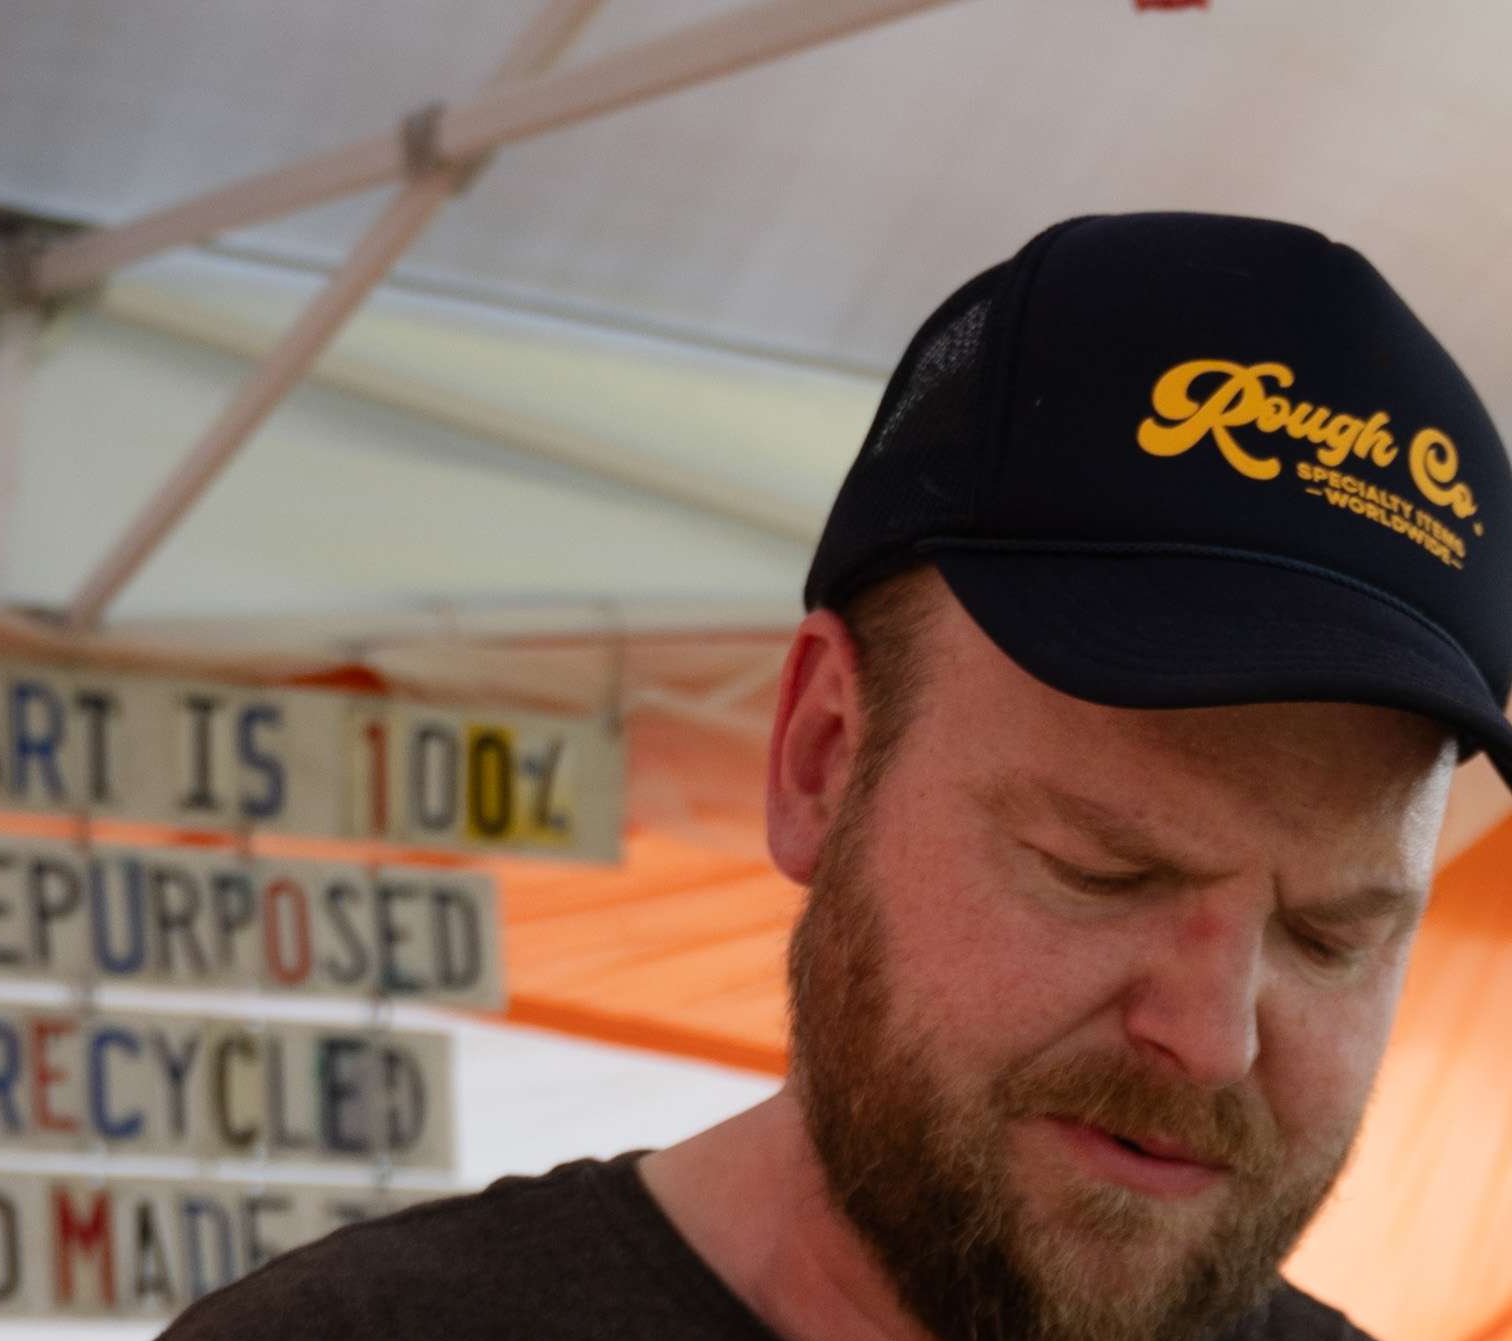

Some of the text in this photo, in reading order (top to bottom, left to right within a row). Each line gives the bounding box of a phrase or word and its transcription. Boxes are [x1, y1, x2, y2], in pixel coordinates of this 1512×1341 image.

[1137, 360, 1398, 480] Rough
[1296, 462, 1414, 518] SPECIALTY
[181, 693, 286, 821] IS
[357, 719, 572, 842] 100%
